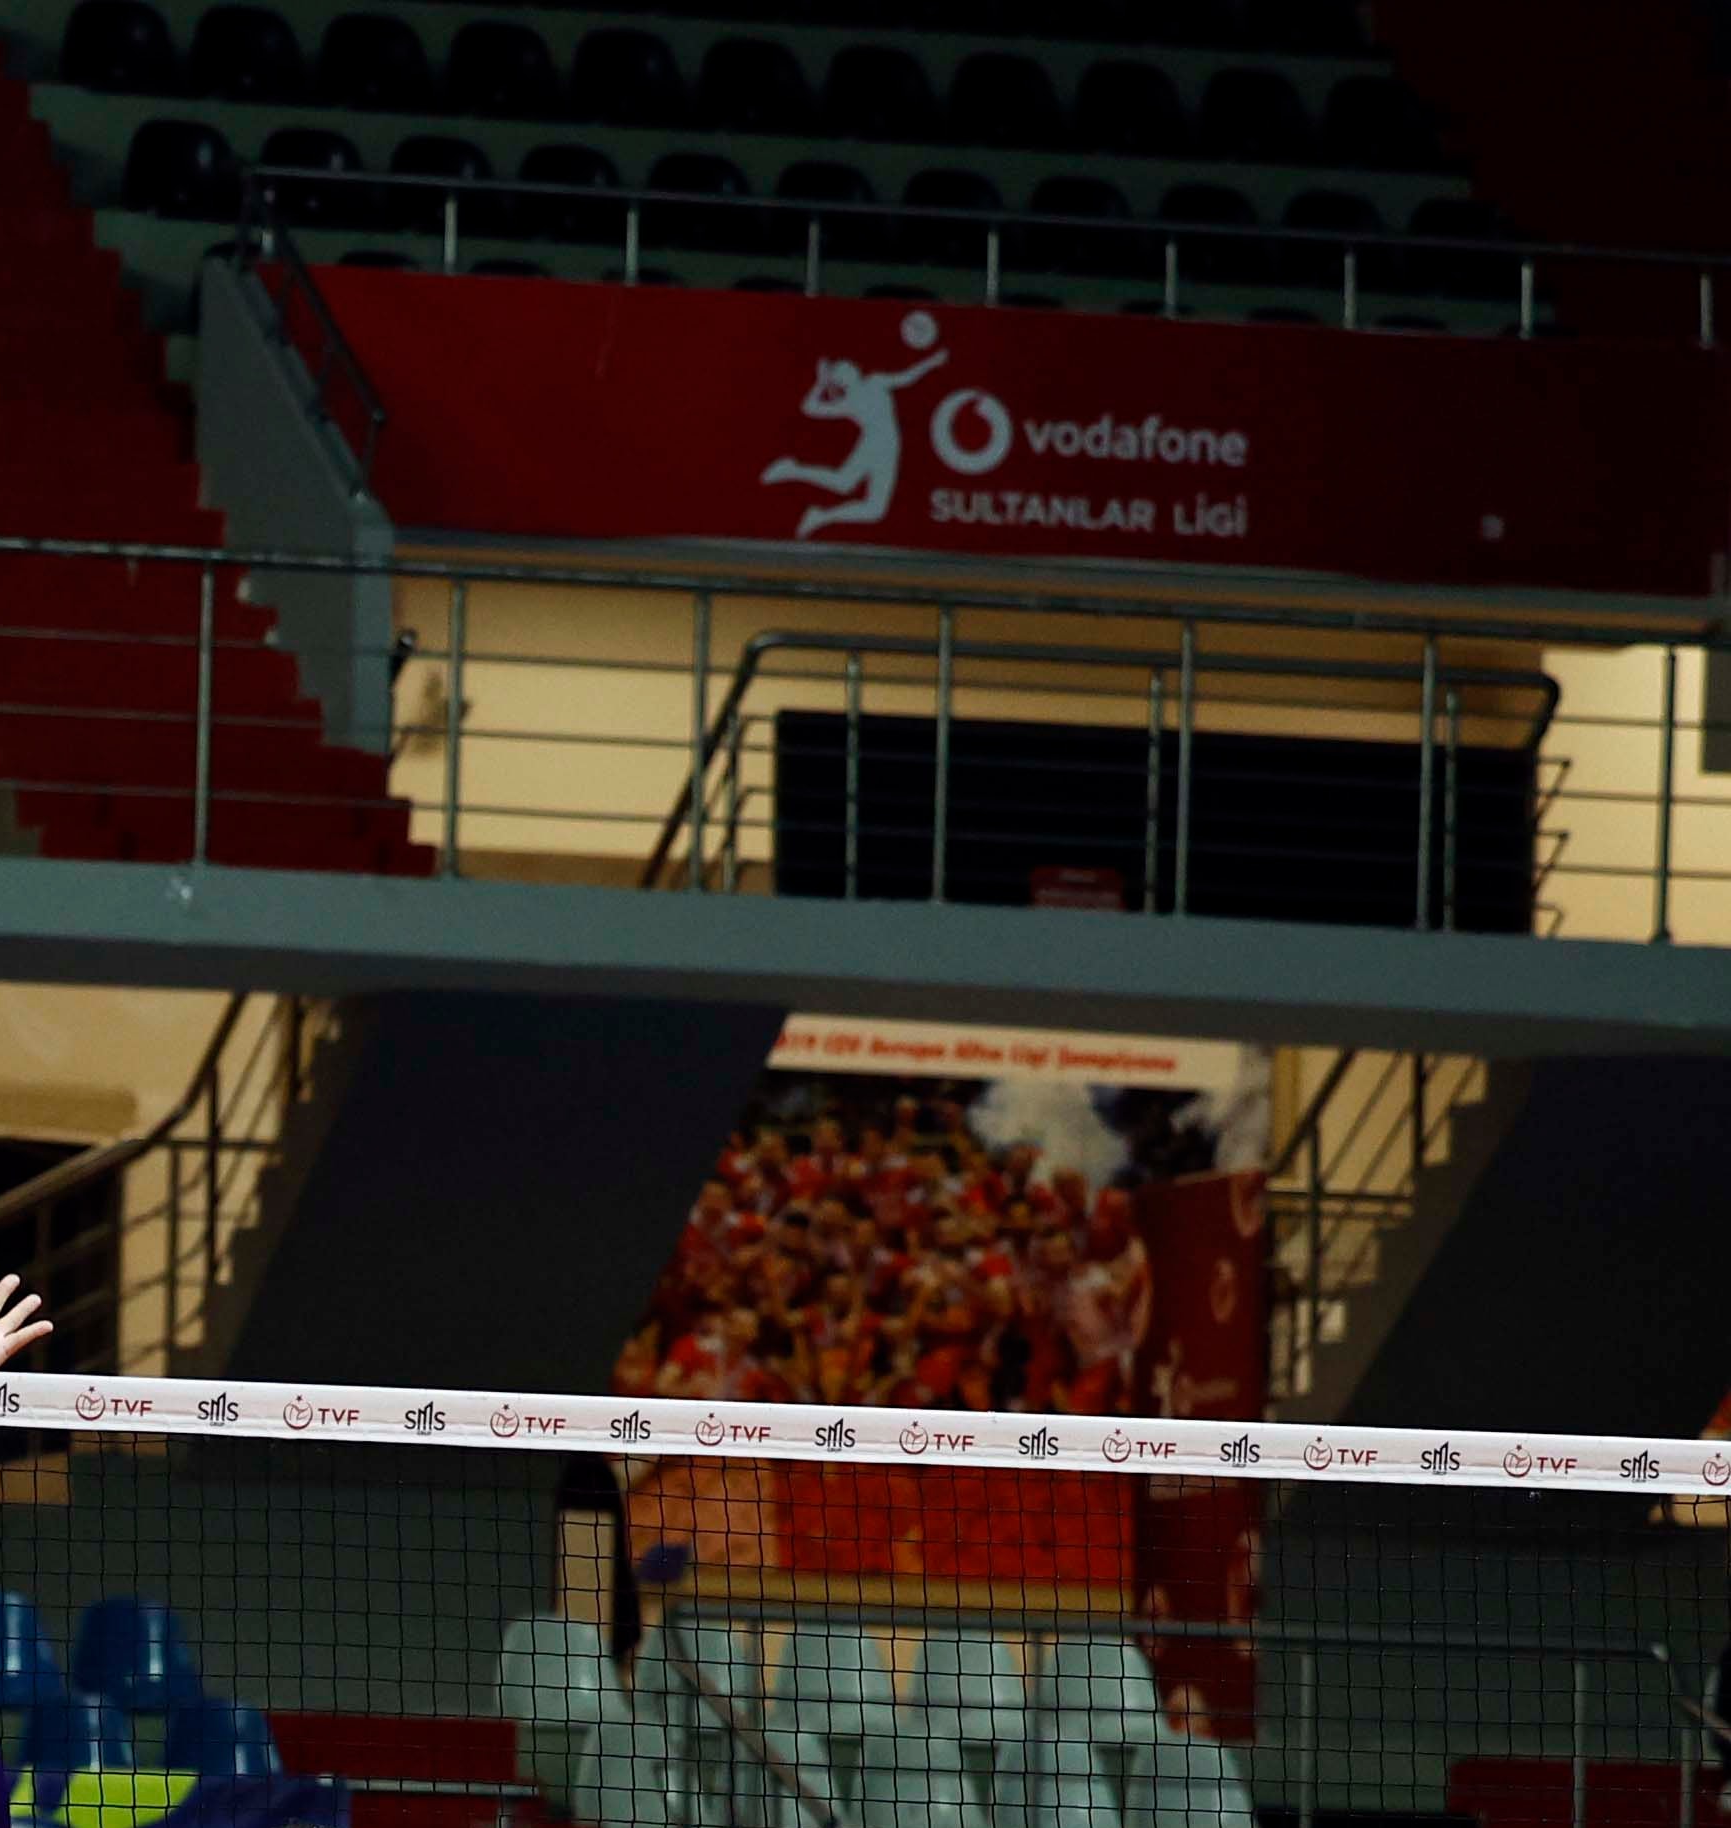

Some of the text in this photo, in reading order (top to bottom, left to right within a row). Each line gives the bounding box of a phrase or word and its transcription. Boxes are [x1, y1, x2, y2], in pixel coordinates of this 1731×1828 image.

[1022, 411, 1250, 468] vodafone
[927, 488, 1250, 540] SULTANLAR LİGİ
[109, 1400, 153, 1419] TVF
[197, 1392, 239, 1425] SMS
[316, 1409, 360, 1427] TVF
[404, 1400, 446, 1434] SMS
[523, 1417, 566, 1436] TVF
[610, 1409, 652, 1442] SMS
[728, 1425, 771, 1444] TVF
[814, 1417, 856, 1450] SMS
[932, 1434, 975, 1452] TVF
[1018, 1425, 1059, 1458] SMS
[1135, 1442, 1177, 1460] TVF
[1219, 1433, 1261, 1467] SMS
[1336, 1450, 1378, 1468] TVF
[1420, 1441, 1461, 1474] SMS
[1535, 1457, 1578, 1476] TVF
[1619, 1449, 1660, 1482] SMS
